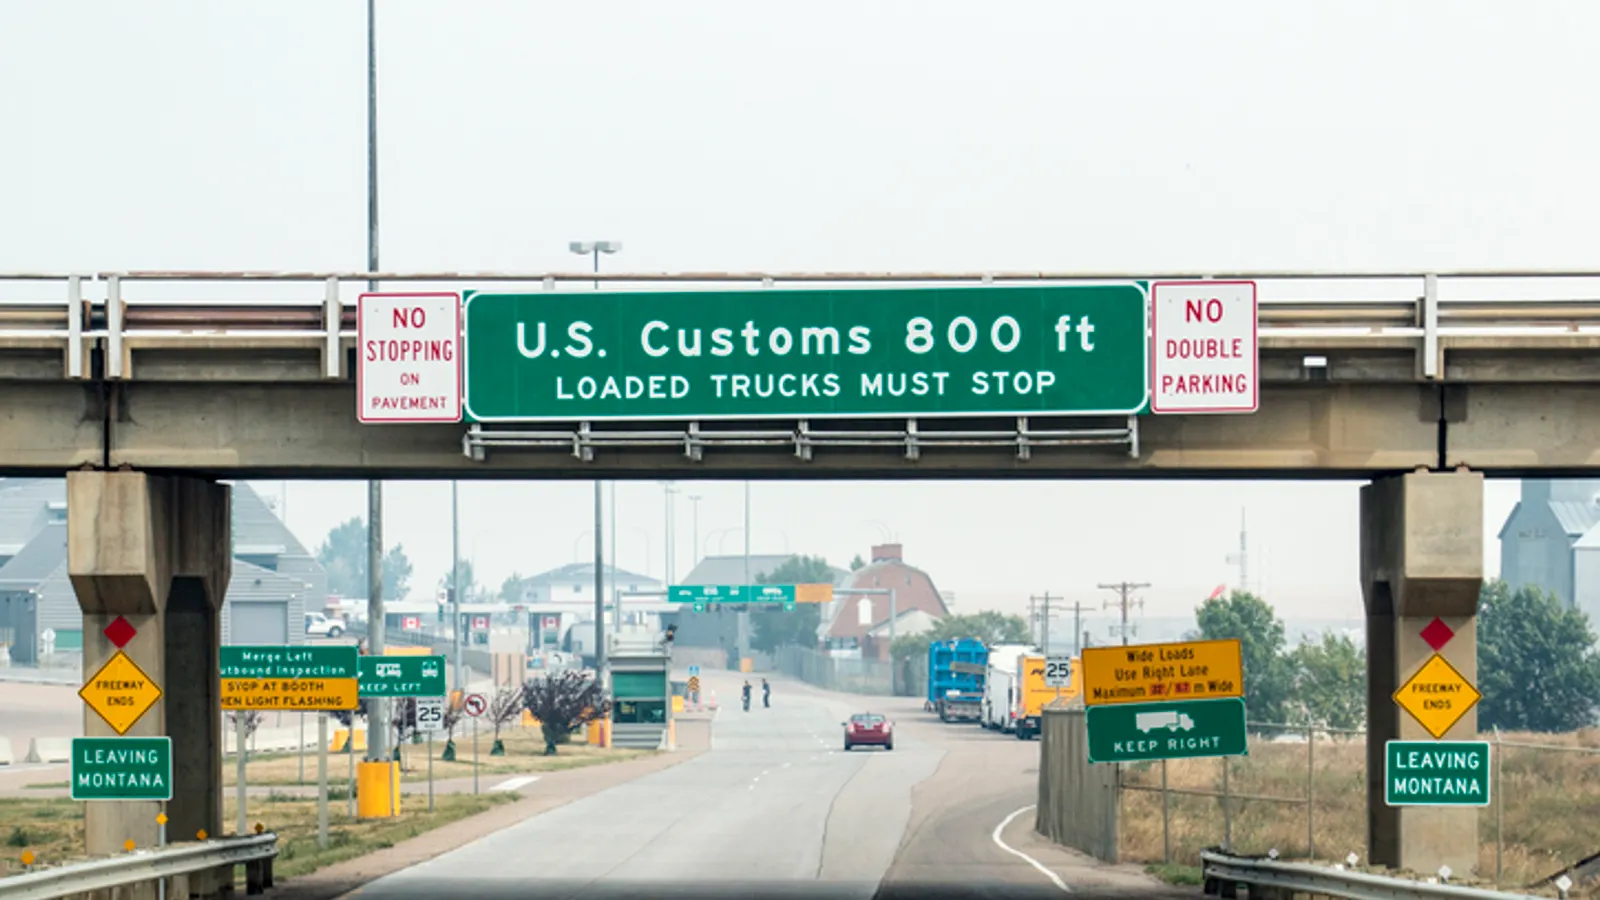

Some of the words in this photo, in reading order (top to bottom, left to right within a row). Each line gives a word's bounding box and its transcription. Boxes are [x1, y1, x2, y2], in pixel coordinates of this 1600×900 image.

[393, 307, 425, 328] NO
[1186, 299, 1223, 323] NO
[517, 321, 606, 358] U.S.
[641, 320, 871, 357] Customs
[905, 315, 1020, 354] 800
[1055, 315, 1094, 352] ft
[367, 340, 452, 361] STOPPING
[1167, 339, 1242, 359] DOUBLE
[400, 373, 419, 385] ON
[557, 376, 689, 399] LOADED
[710, 373, 840, 397] TRUCKS
[861, 372, 949, 396] MUST
[972, 371, 1055, 394] STOP
[1163, 374, 1246, 393] PARKING
[372, 396, 446, 409] PAVEMENT
[243, 652, 280, 663] Merge
[287, 652, 312, 661] Left
[1128, 651, 1153, 662] Wide
[1160, 648, 1194, 661] Loads
[220, 666, 271, 675] utbound
[276, 666, 345, 677] Inspection
[1047, 663, 1069, 678] 25
[1115, 669, 1136, 681] Use
[1143, 666, 1174, 681] Right
[1180, 665, 1208, 677] Lane
[96, 681, 144, 690] FREEWAY
[228, 682, 258, 692] STOP
[263, 682, 276, 690] AT
[282, 681, 324, 691] BOOTH
[393, 683, 421, 692] LEFT
[1093, 687, 1144, 698] Maximum
[1208, 681, 1233, 692] Wide
[1411, 683, 1461, 694] FREEWAY
[107, 696, 134, 706] ENDS
[246, 696, 279, 706] LIGHT
[283, 696, 343, 706] FLASHING
[1423, 699, 1451, 710] ENDS
[419, 707, 441, 721] 25
[1114, 740, 1158, 752] KEEP
[1168, 736, 1219, 750] RIGHT
[84, 750, 158, 764] LEAVING
[1396, 752, 1480, 769] LEAVING
[79, 773, 164, 787] MONTANA
[1395, 778, 1480, 794] MONTANA
